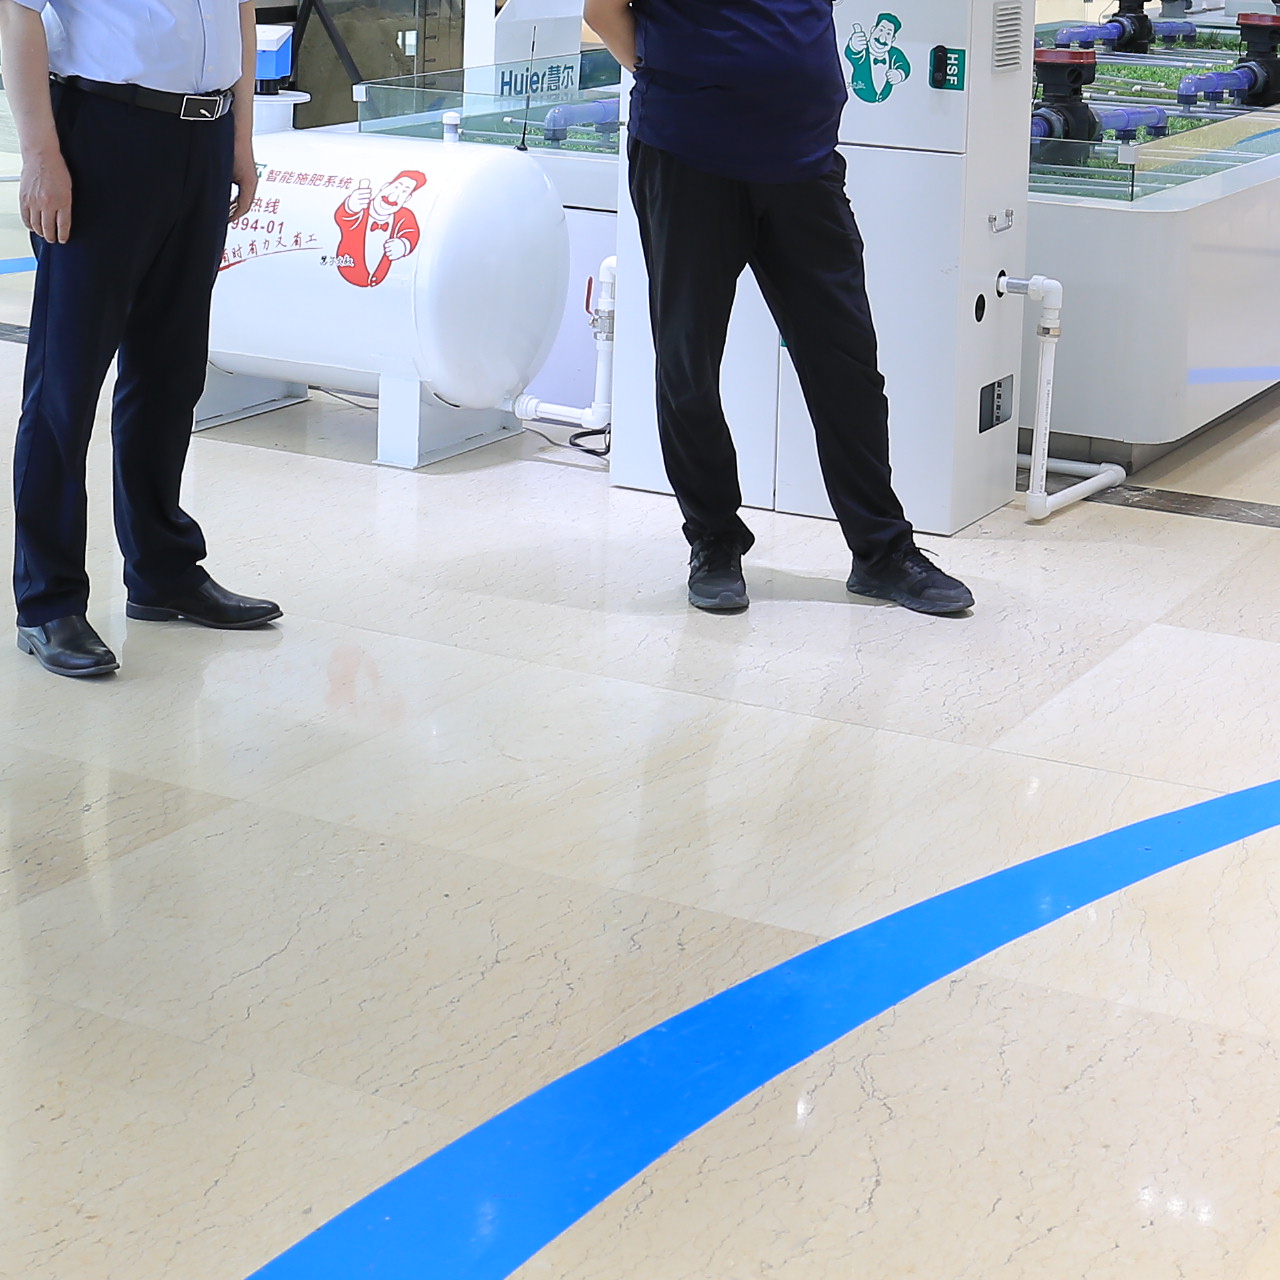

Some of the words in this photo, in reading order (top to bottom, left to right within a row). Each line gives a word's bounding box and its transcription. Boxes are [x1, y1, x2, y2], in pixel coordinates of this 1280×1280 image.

[501, 64, 574, 97] Huier慧尔
[947, 53, 959, 86] HSF
[266, 169, 354, 190] 智能施肥系统
